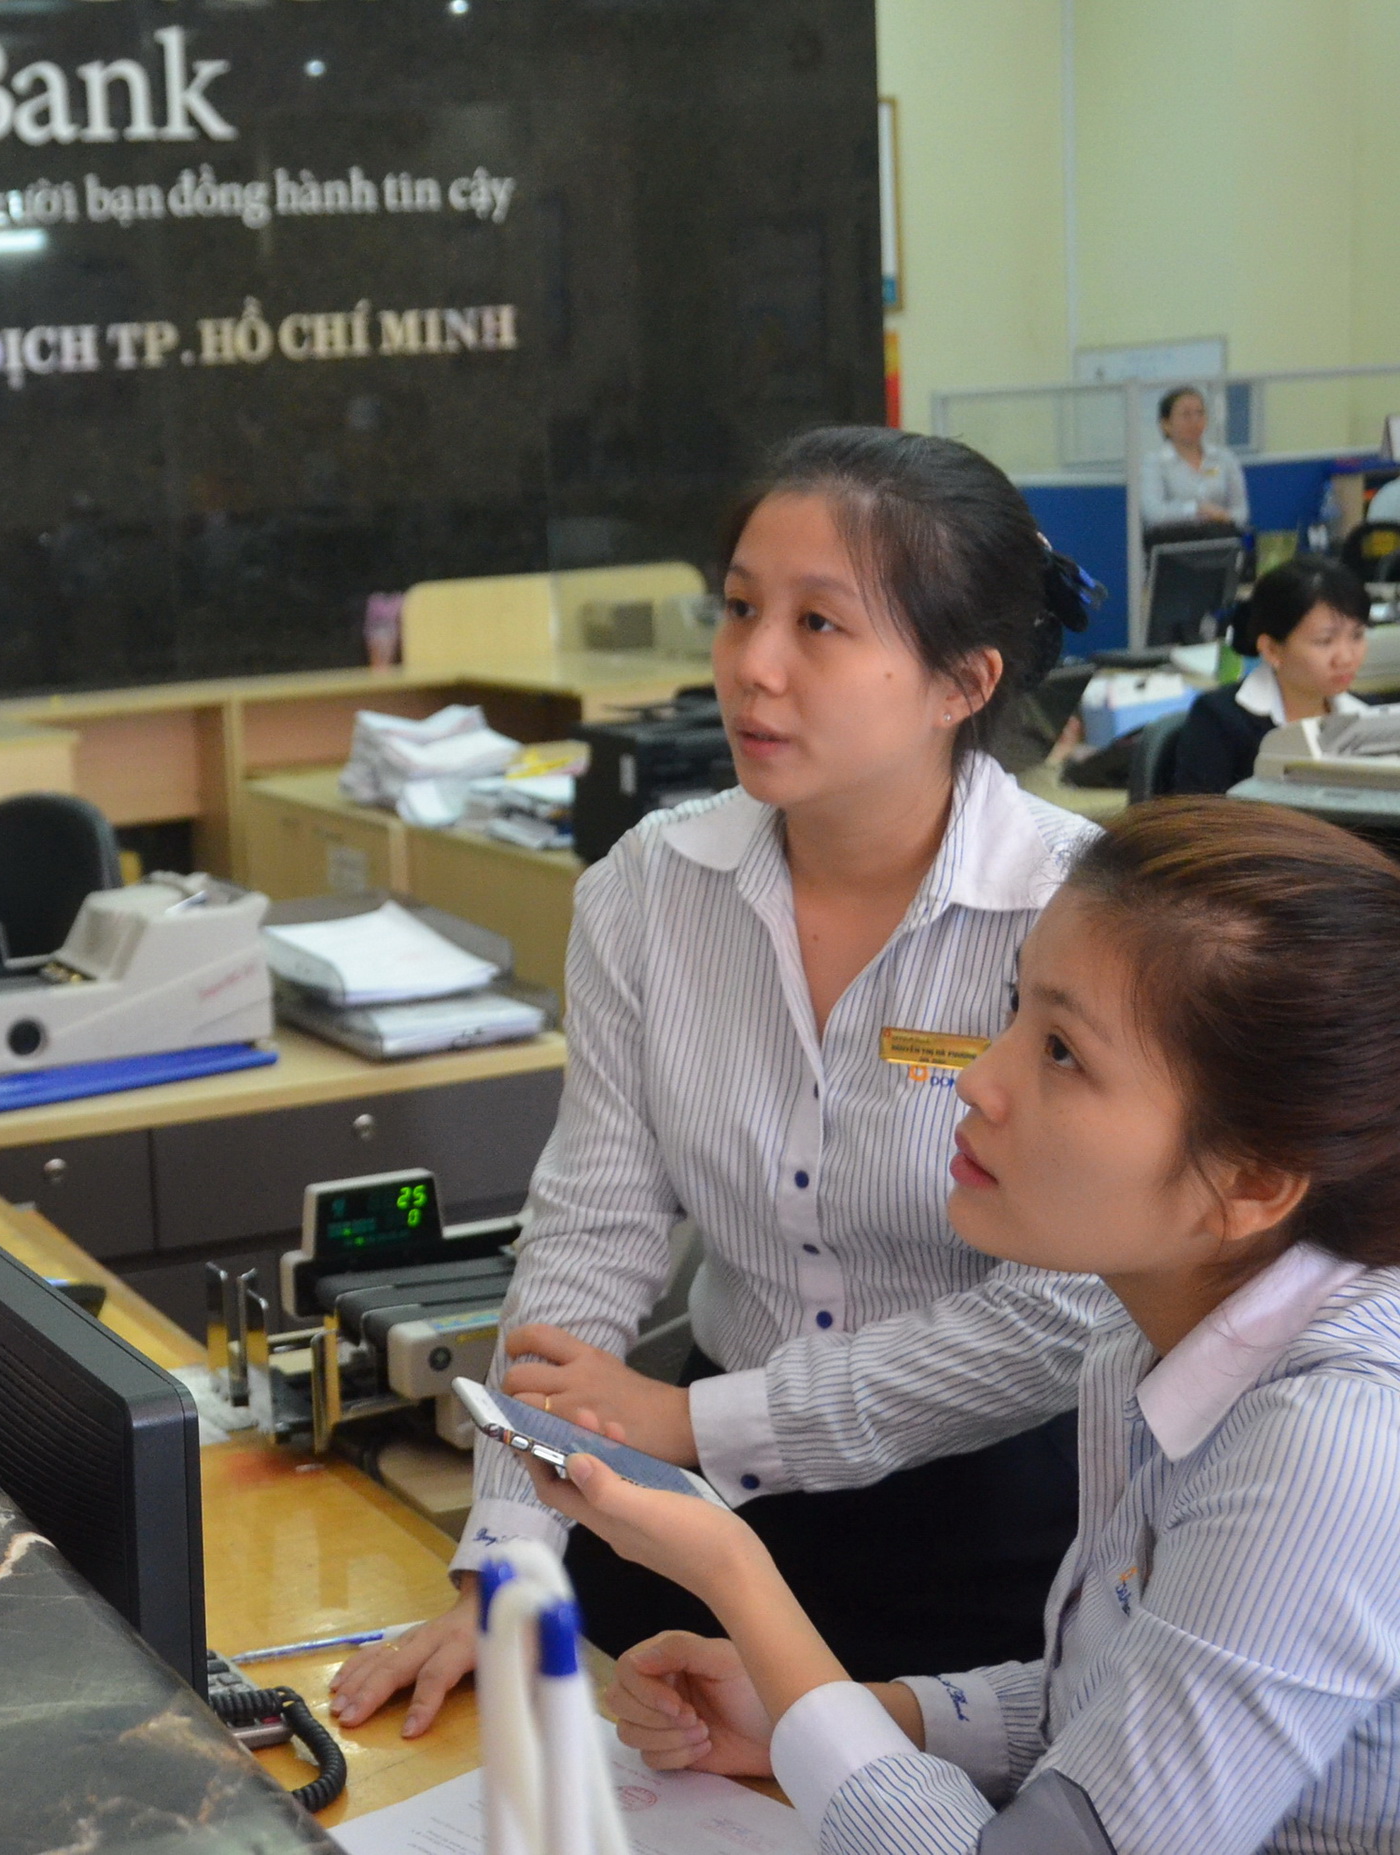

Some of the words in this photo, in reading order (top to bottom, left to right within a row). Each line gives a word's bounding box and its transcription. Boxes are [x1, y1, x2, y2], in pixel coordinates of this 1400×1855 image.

[84, 172, 165, 228] bạn
[167, 162, 271, 229] đồng
[274, 166, 378, 215] hành
[382, 171, 442, 213] tin
[449, 165, 516, 224] cậy
[197, 295, 274, 365] HỒ
[277, 298, 372, 362] CHÍ
[379, 303, 518, 356] MINH
[397, 1185, 427, 1209] 25
[407, 1208, 422, 1227] 0
